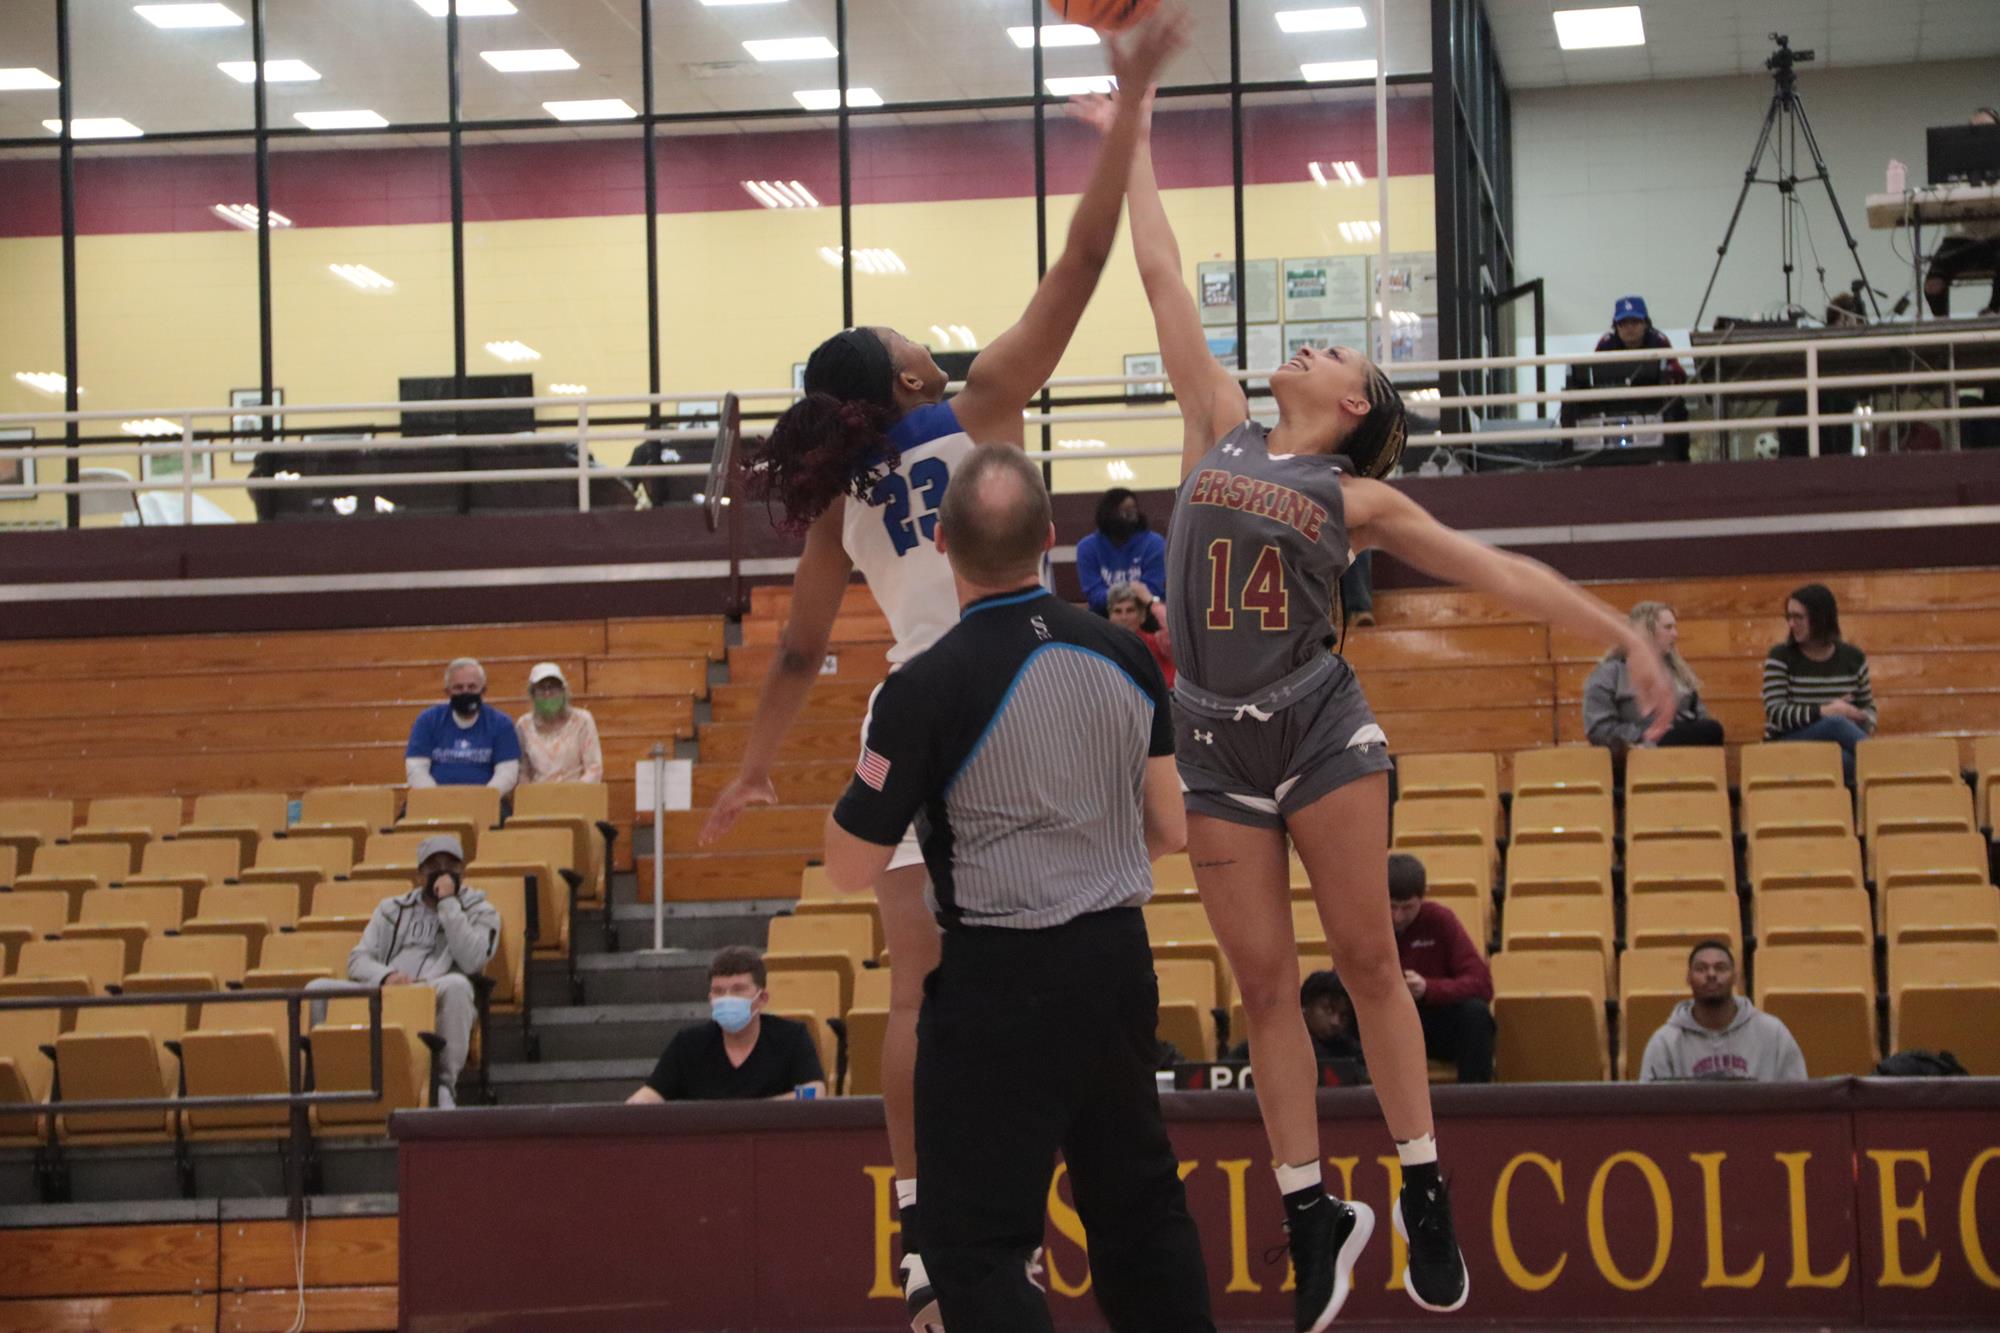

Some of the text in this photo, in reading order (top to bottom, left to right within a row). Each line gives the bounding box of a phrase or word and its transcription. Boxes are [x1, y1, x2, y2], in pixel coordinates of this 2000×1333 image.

[871, 456, 950, 557] 23
[1189, 468, 1329, 545] ERSKINE
[1206, 538, 1289, 631] 14
